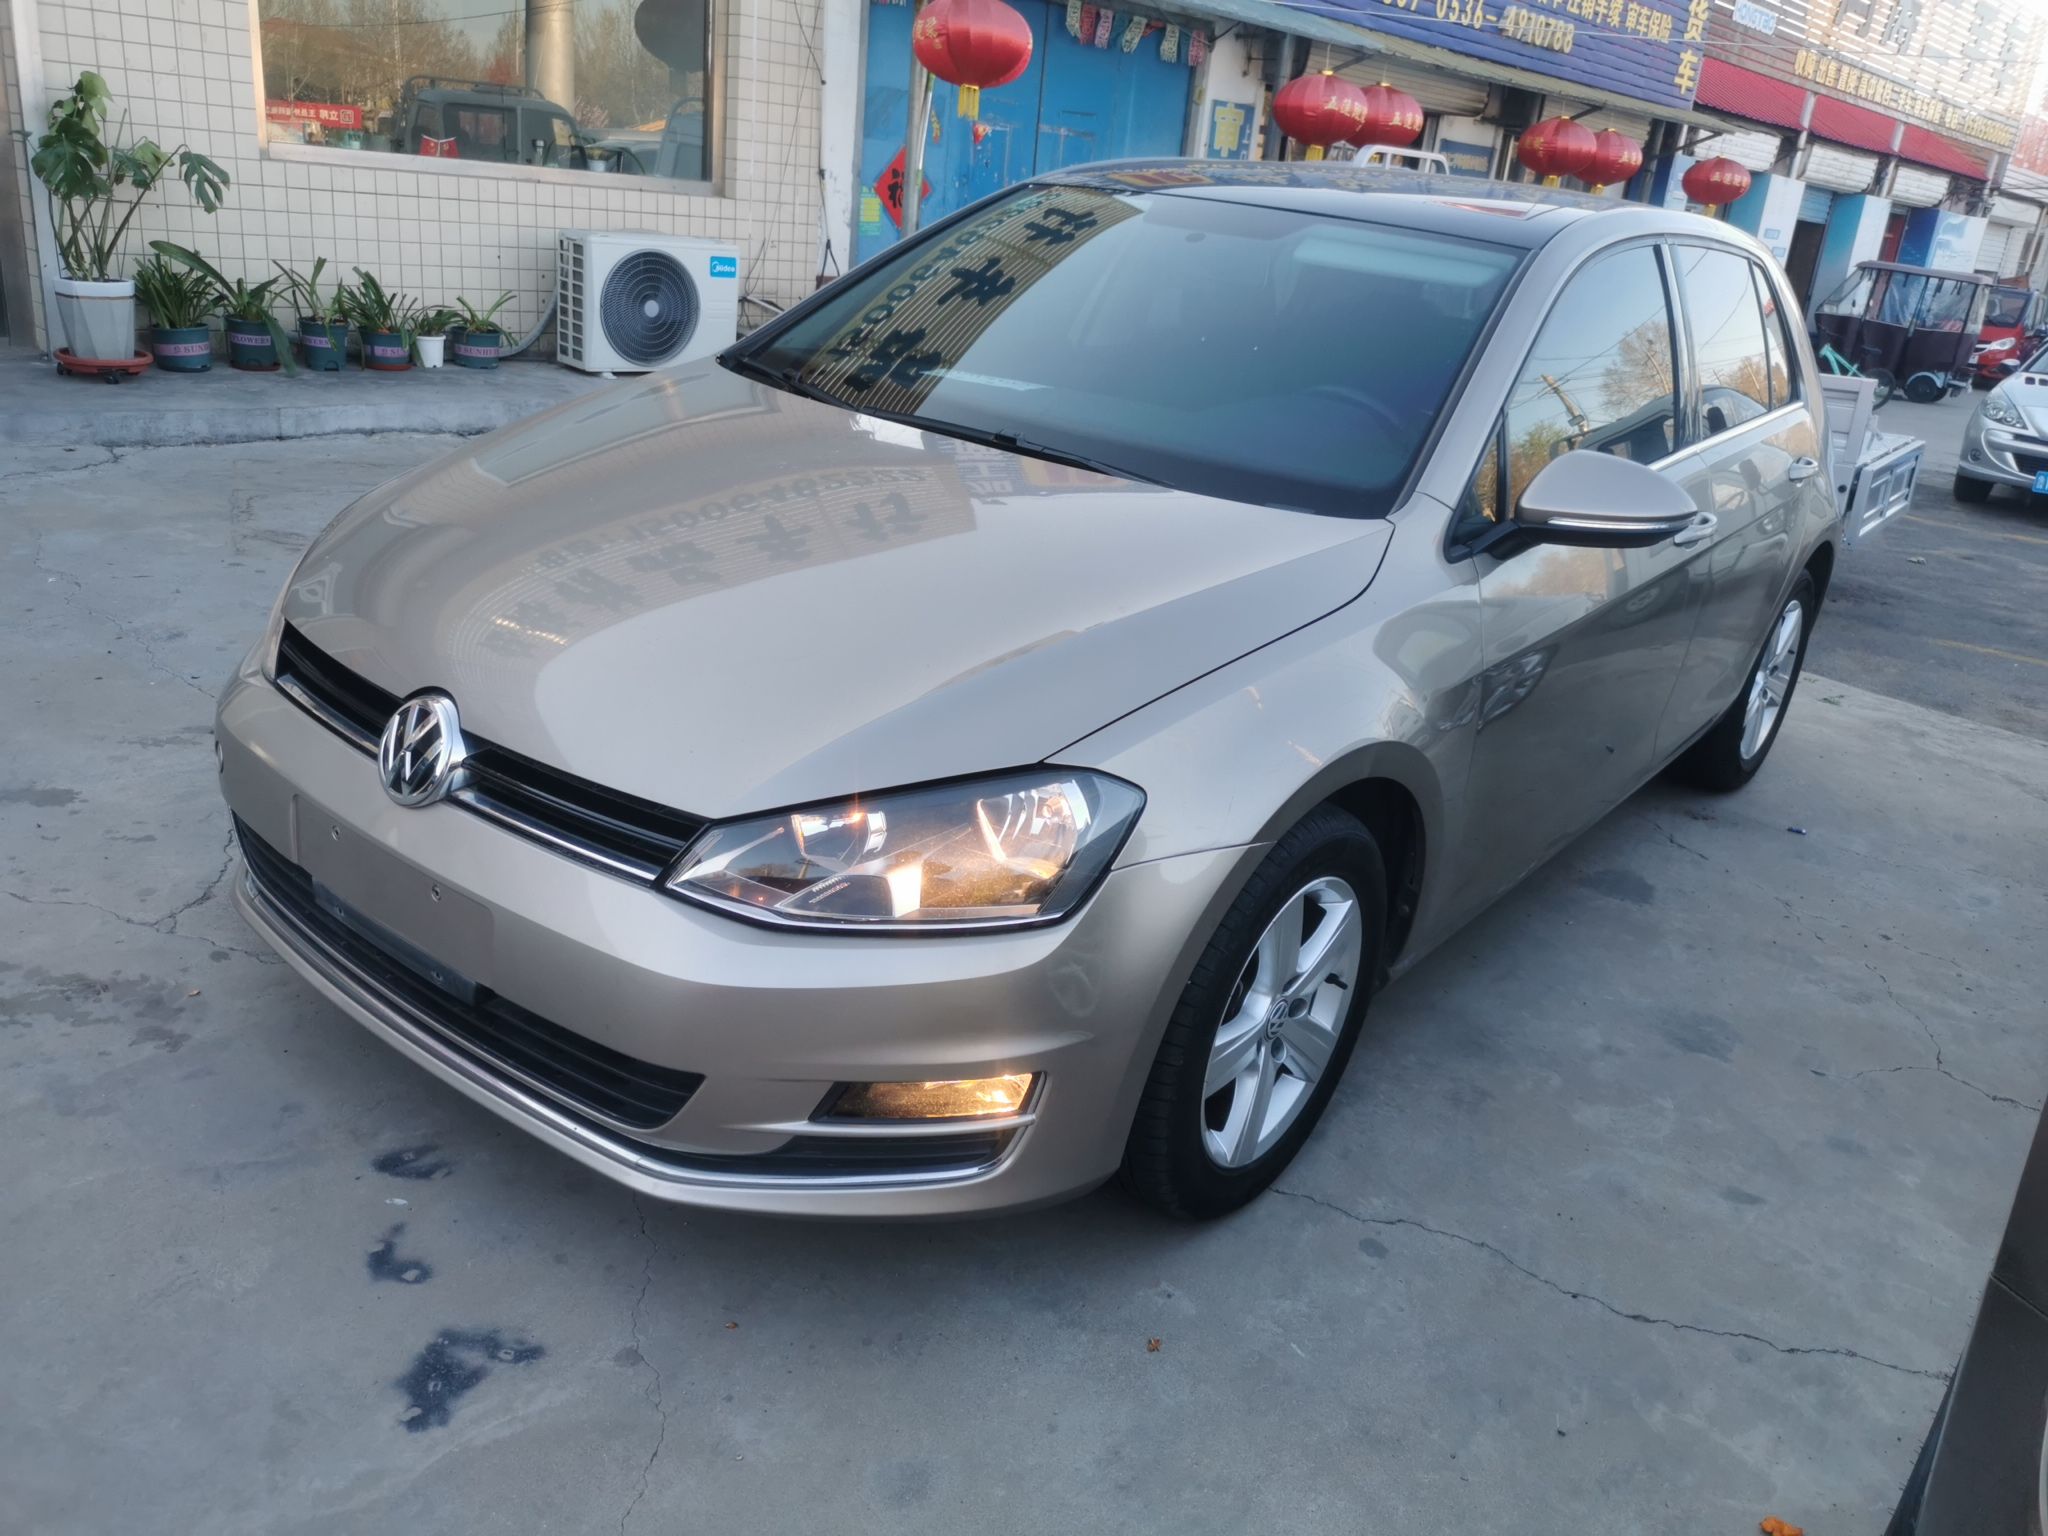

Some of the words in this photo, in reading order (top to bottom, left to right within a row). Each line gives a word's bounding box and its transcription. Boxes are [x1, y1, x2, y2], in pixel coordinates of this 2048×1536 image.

[1625, 3, 1673, 44] 审车保险
[711, 260, 736, 273] Midea
